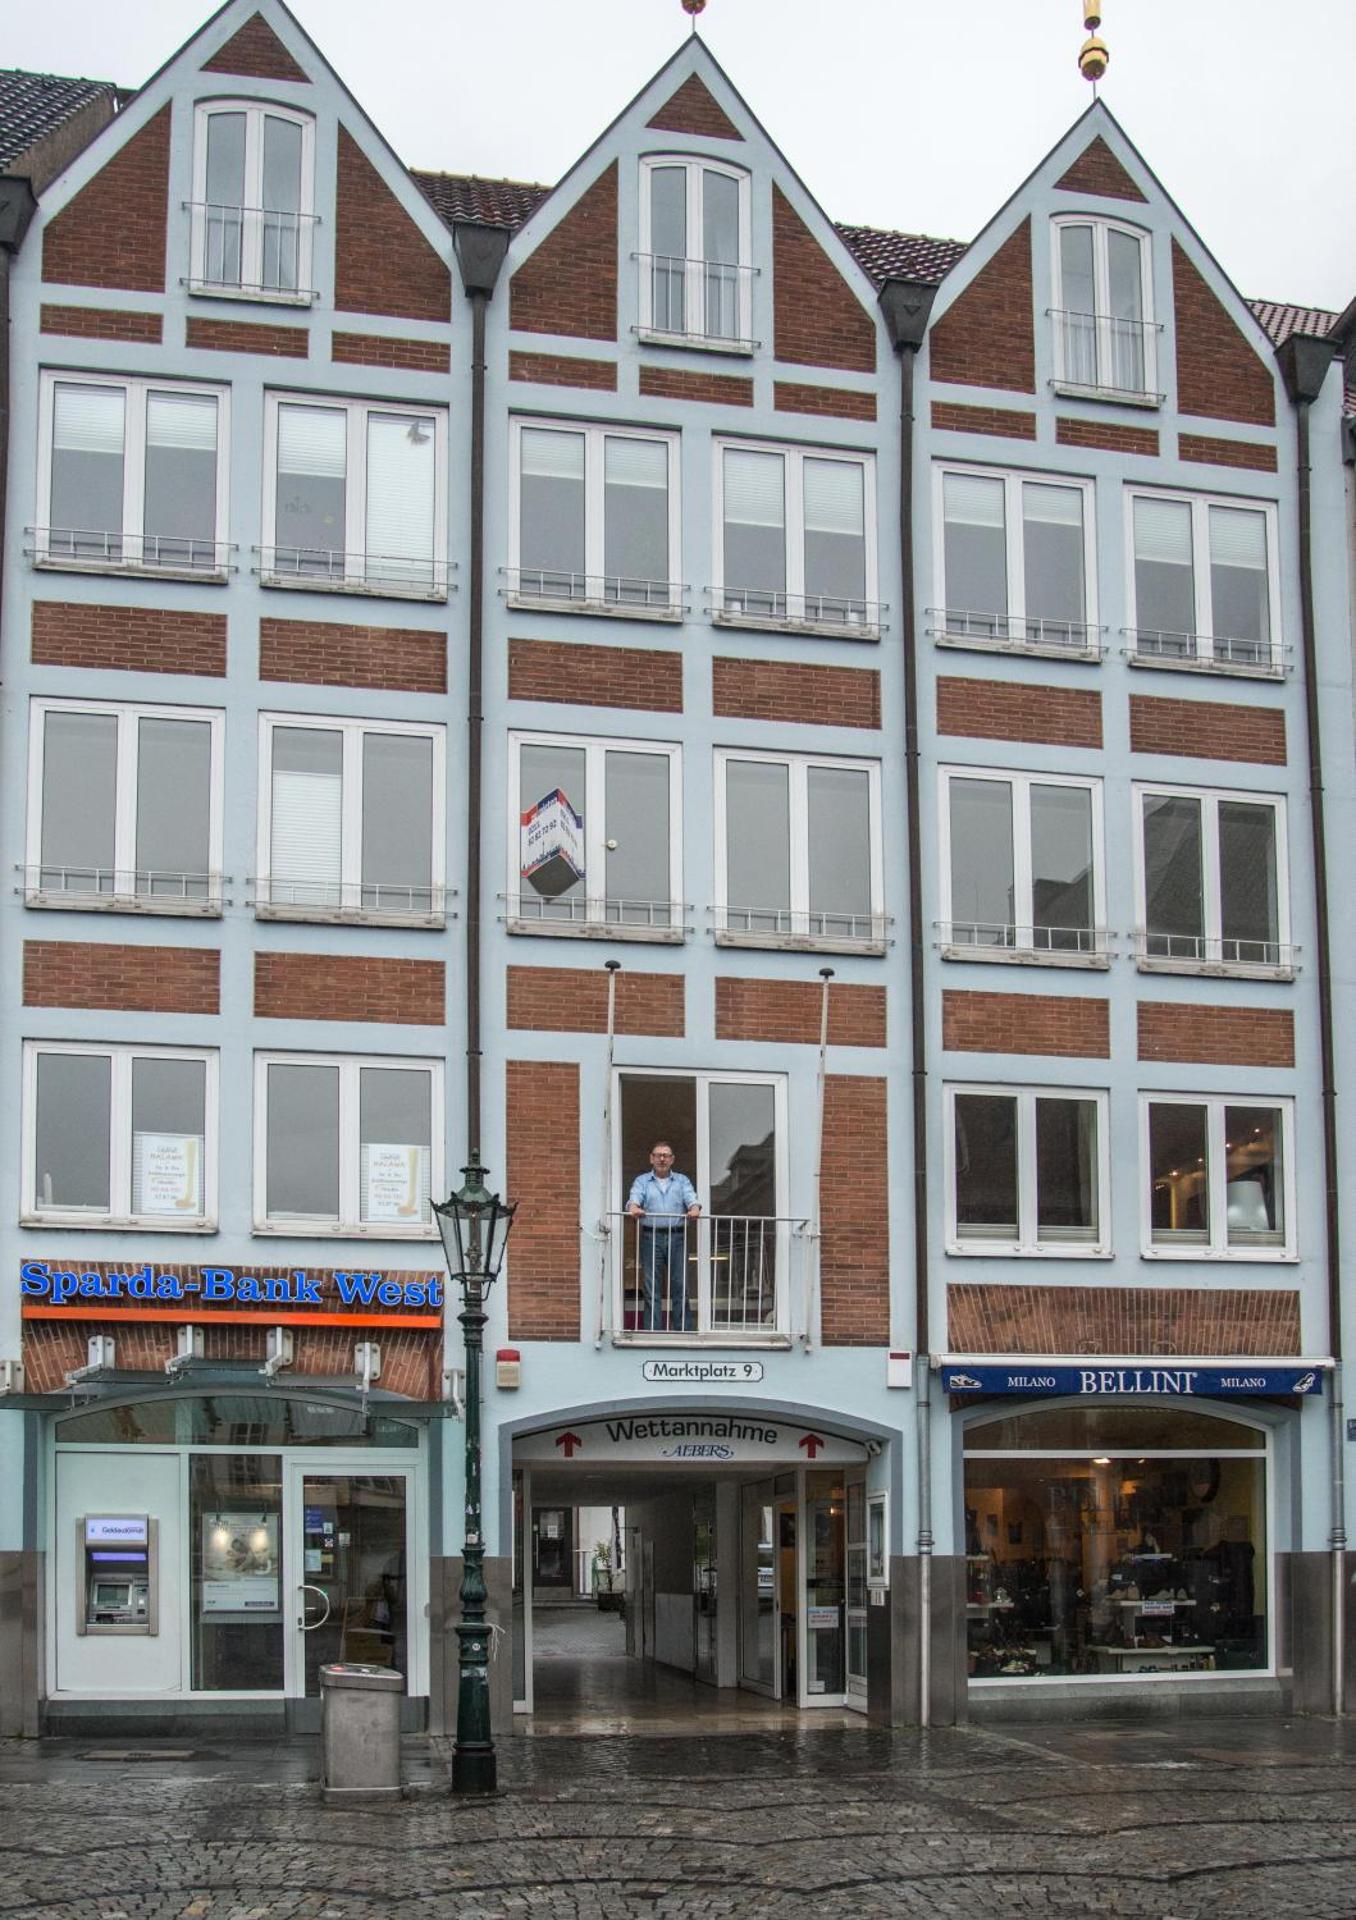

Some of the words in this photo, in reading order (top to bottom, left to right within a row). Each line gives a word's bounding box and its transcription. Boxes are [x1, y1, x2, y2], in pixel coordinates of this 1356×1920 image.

[21, 1263, 322, 1304] Sparda-Bank
[334, 1271, 443, 1307] West
[653, 1363, 736, 1380] Marktplatz
[743, 1364, 753, 1377] 9
[1008, 1376, 1056, 1388] MILANO
[1080, 1371, 1194, 1393] BELLINI
[1220, 1377, 1266, 1388] MILANO
[606, 1419, 778, 1444] Wettannahme
